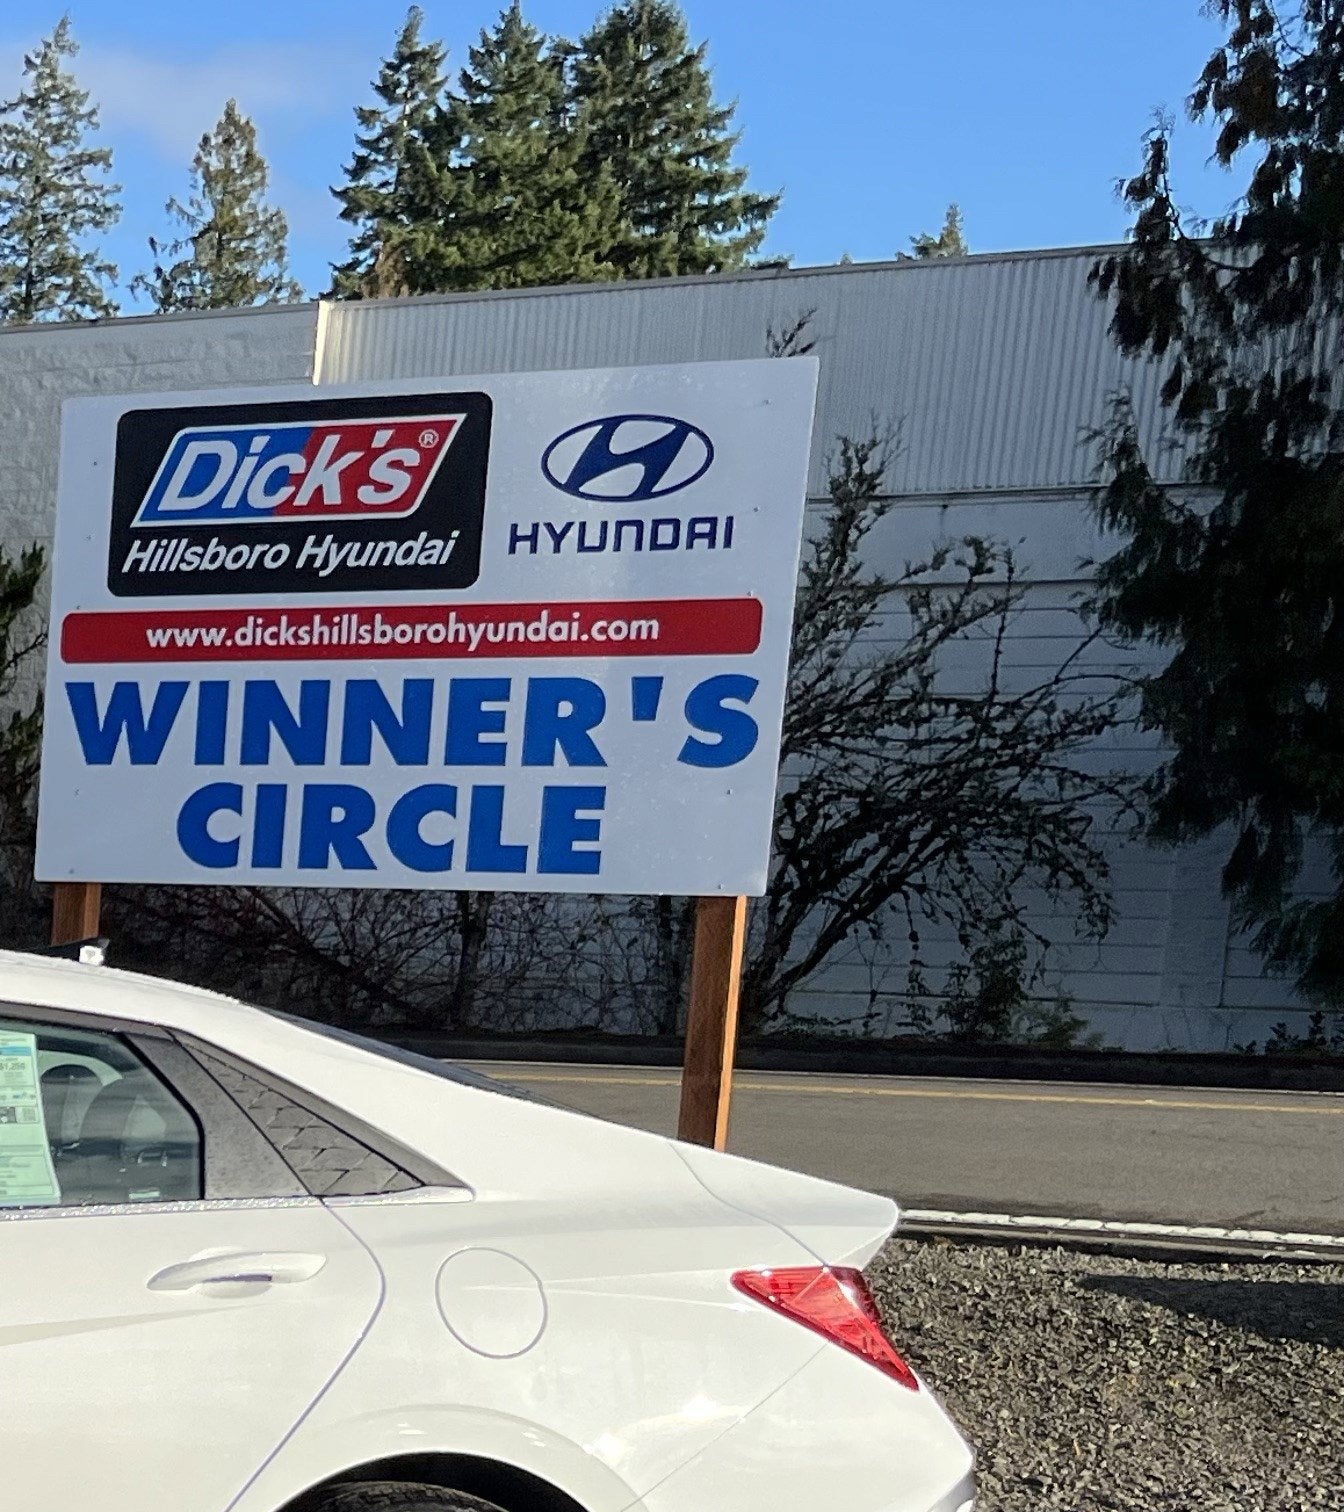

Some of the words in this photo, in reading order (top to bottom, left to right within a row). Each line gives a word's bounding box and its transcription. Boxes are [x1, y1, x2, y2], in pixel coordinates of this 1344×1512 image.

[121, 538, 292, 575] Hillsboro
[296, 530, 461, 577] Hyundai
[508, 515, 735, 556] HYUNDAI
[145, 613, 661, 653] www.dickshillsborohyundai.com
[63, 673, 761, 769] WINNER'S
[175, 781, 608, 877] CIRCLE
